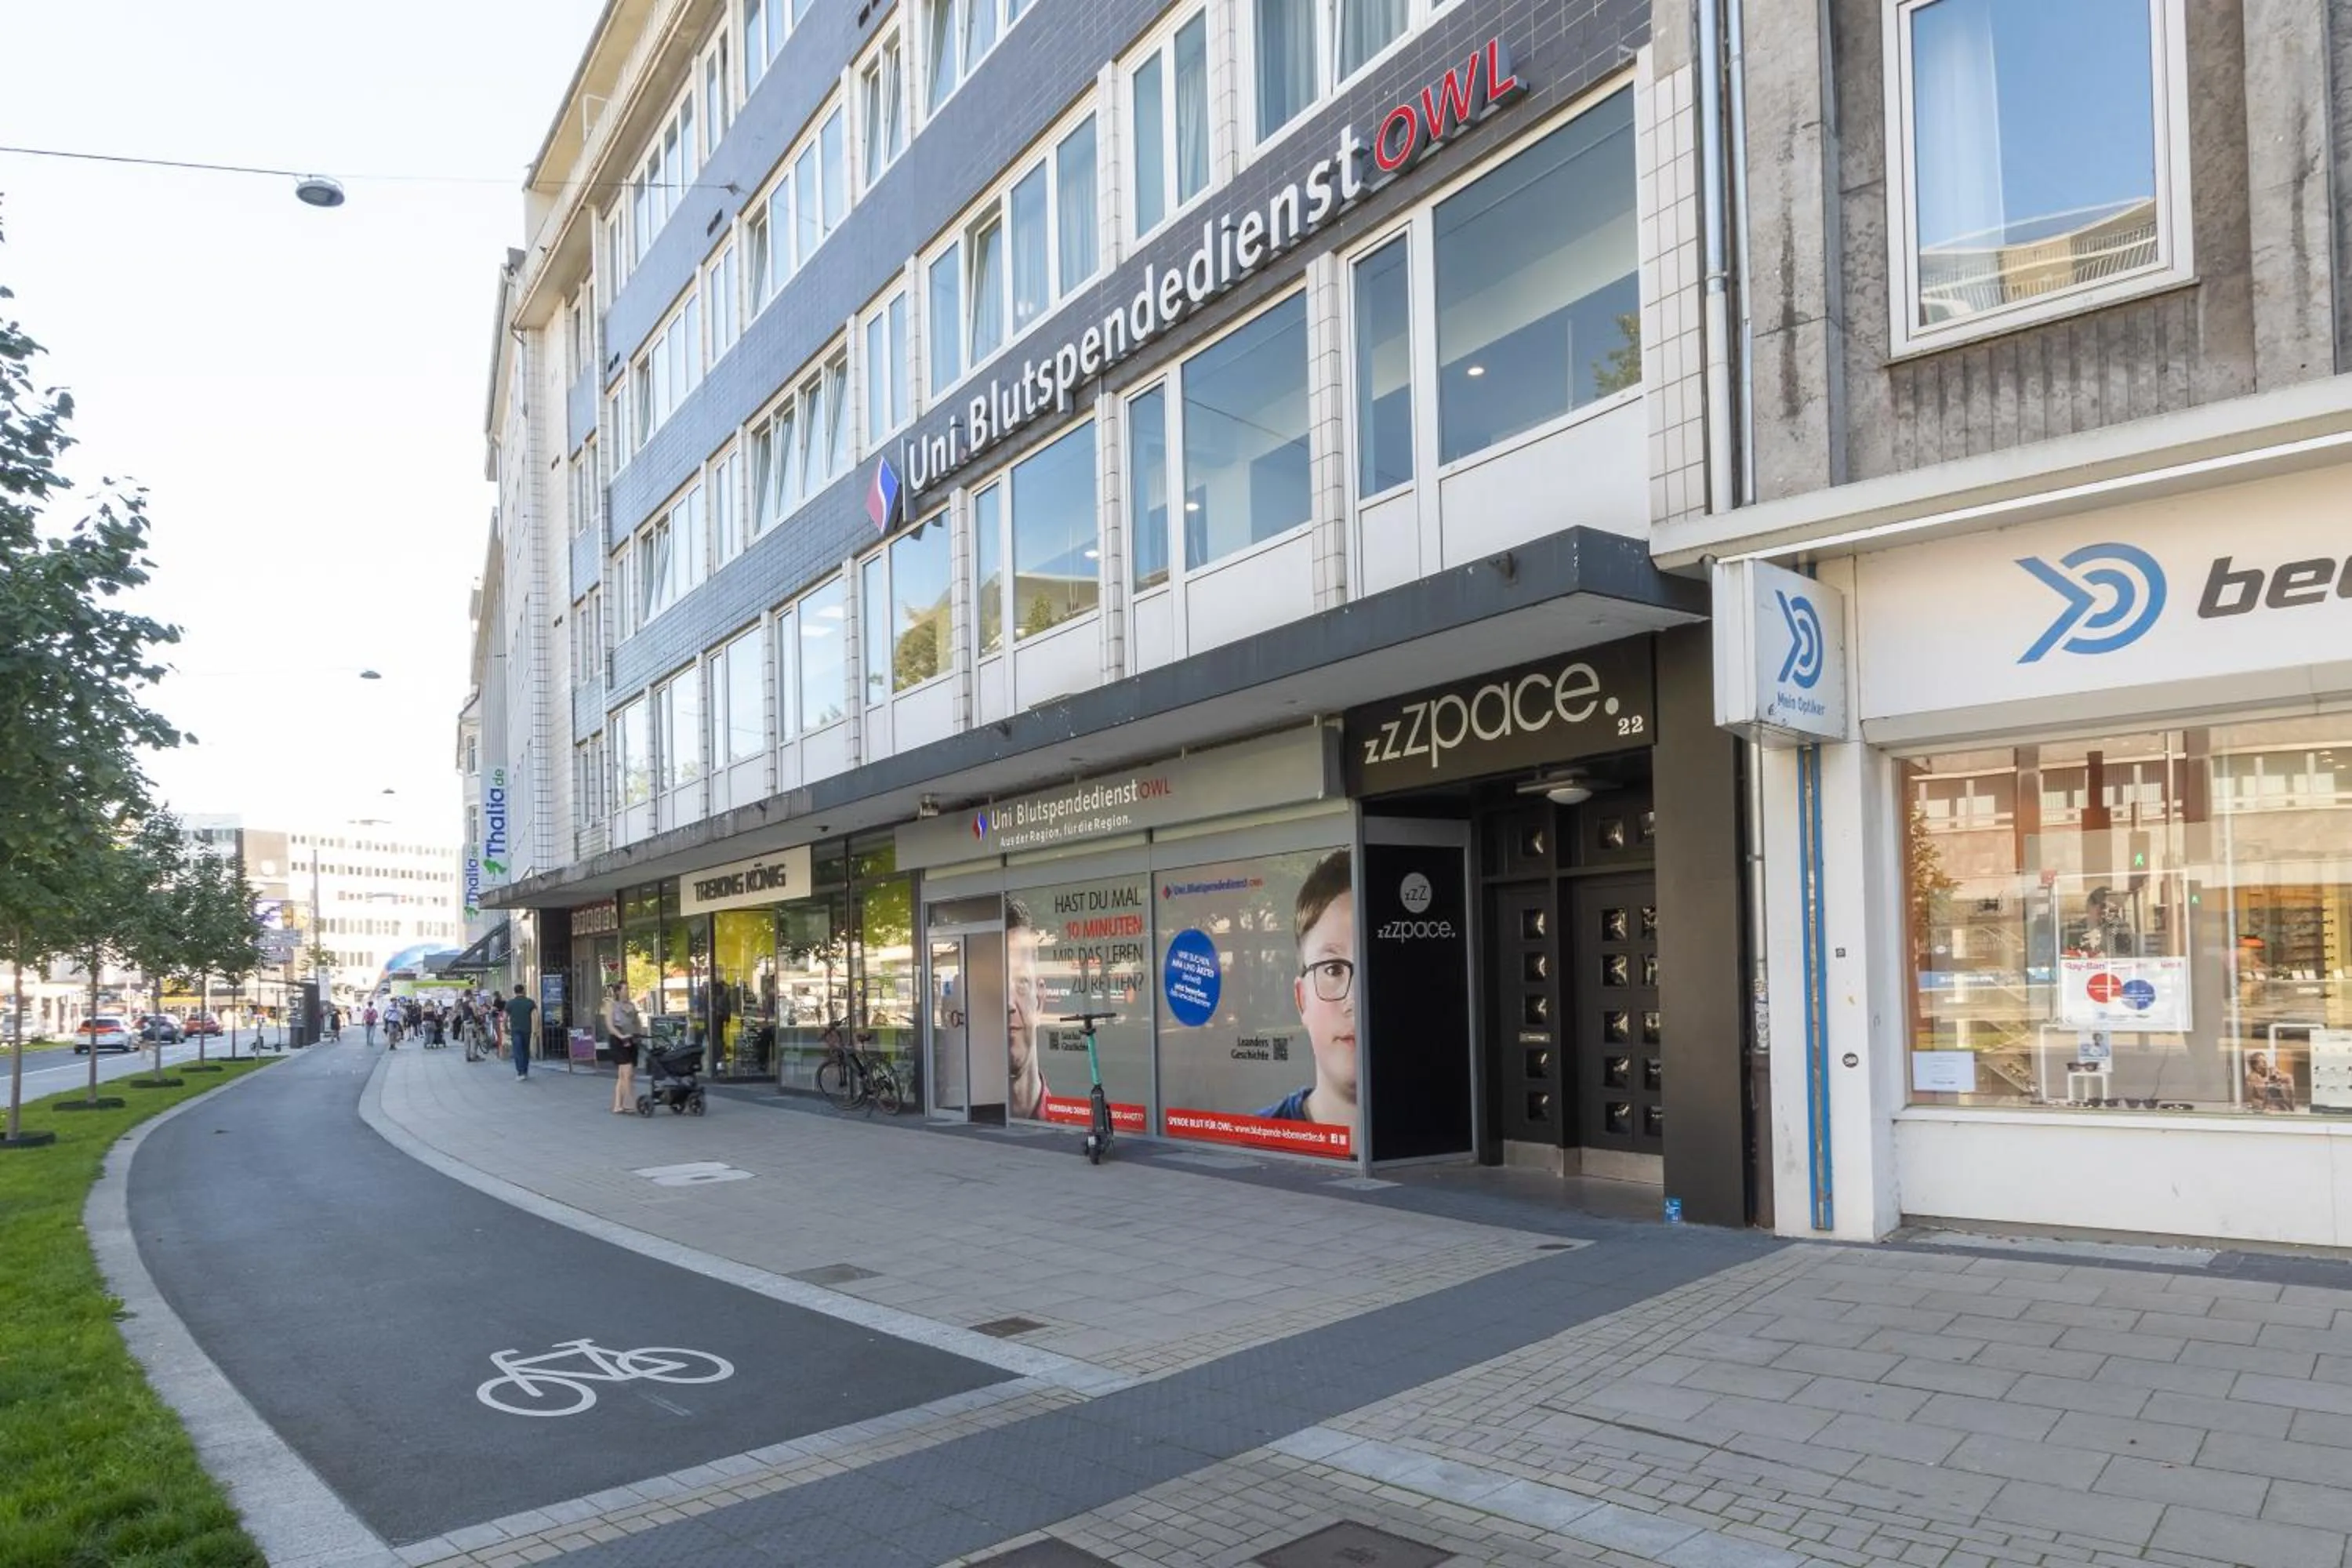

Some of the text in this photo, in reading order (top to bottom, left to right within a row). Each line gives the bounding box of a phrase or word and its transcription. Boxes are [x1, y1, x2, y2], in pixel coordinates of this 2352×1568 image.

[970, 124, 1361, 454] Blutspendedienst
[1375, 37, 1518, 172] OWL
[2198, 554, 2352, 619] be
[1777, 691, 1826, 716] Mein Optiker
[1617, 714, 1644, 735] 22
[1016, 778, 1138, 825] Blutspendedienst
[1139, 777, 1173, 799] OWL
[746, 862, 786, 893] KÖNIG
[1054, 887, 1142, 913] HAST DU MAL
[1065, 914, 1143, 939] 10 MINUTEN
[1078, 946, 1102, 967] DAS
[1106, 943, 1144, 964] LEBEN
[1073, 975, 1087, 993] ZU
[1091, 971, 1144, 993] RETTEN?
[1230, 1048, 1269, 1060] Geschichte
